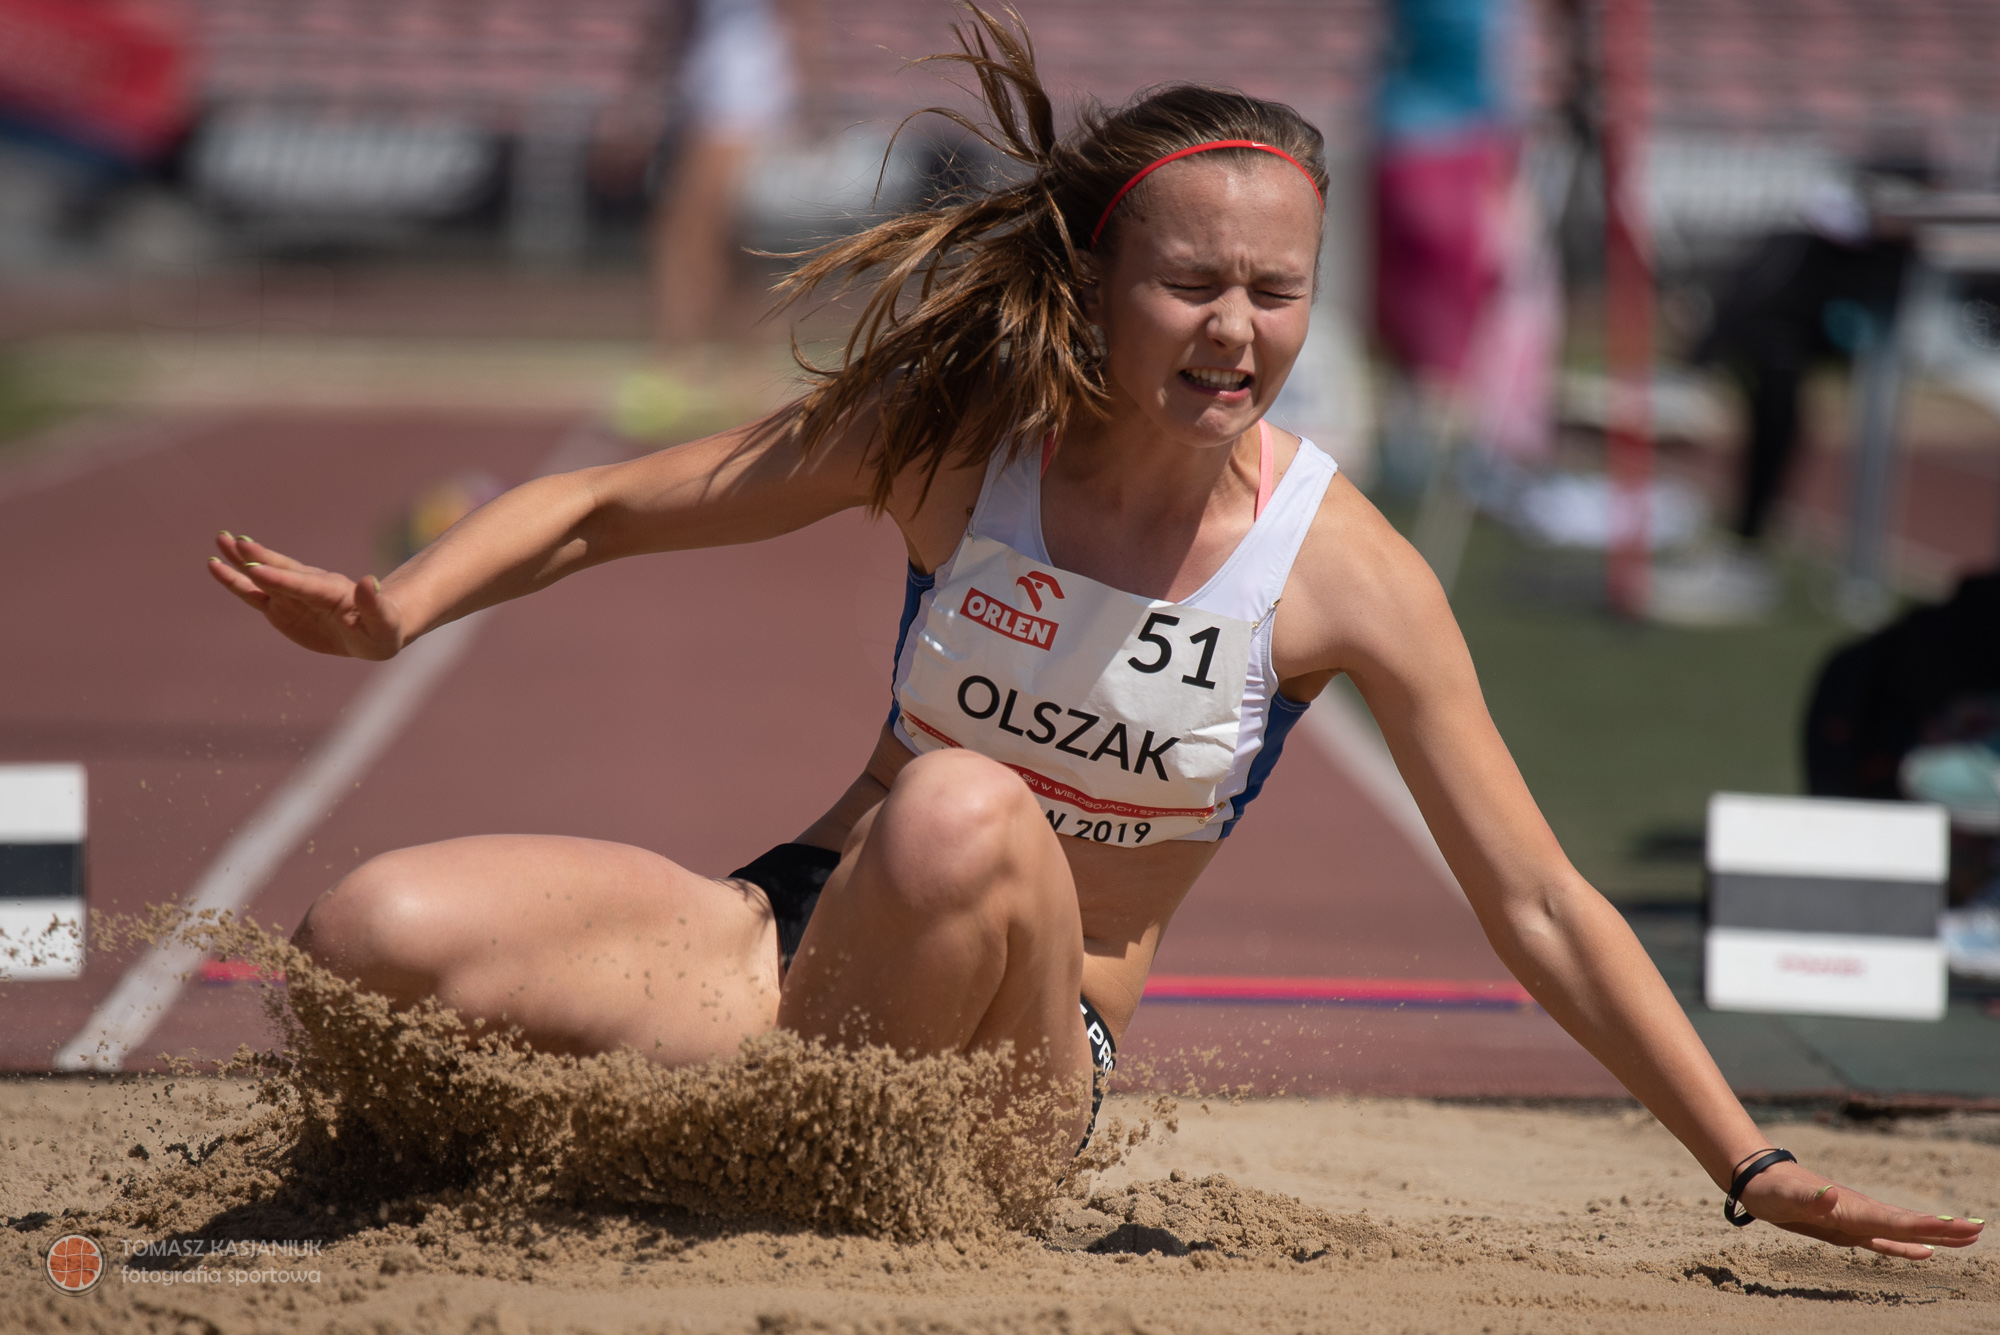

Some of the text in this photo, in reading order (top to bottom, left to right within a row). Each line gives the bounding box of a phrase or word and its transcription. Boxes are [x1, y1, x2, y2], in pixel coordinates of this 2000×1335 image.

[967, 595, 1052, 646] ORLEN
[1128, 612, 1221, 690] 51
[957, 675, 1181, 782] OLSZAK
[1041, 782, 1052, 791] W
[1054, 787, 1132, 813] WIELOBOJACH
[1073, 818, 1152, 844] 2019
